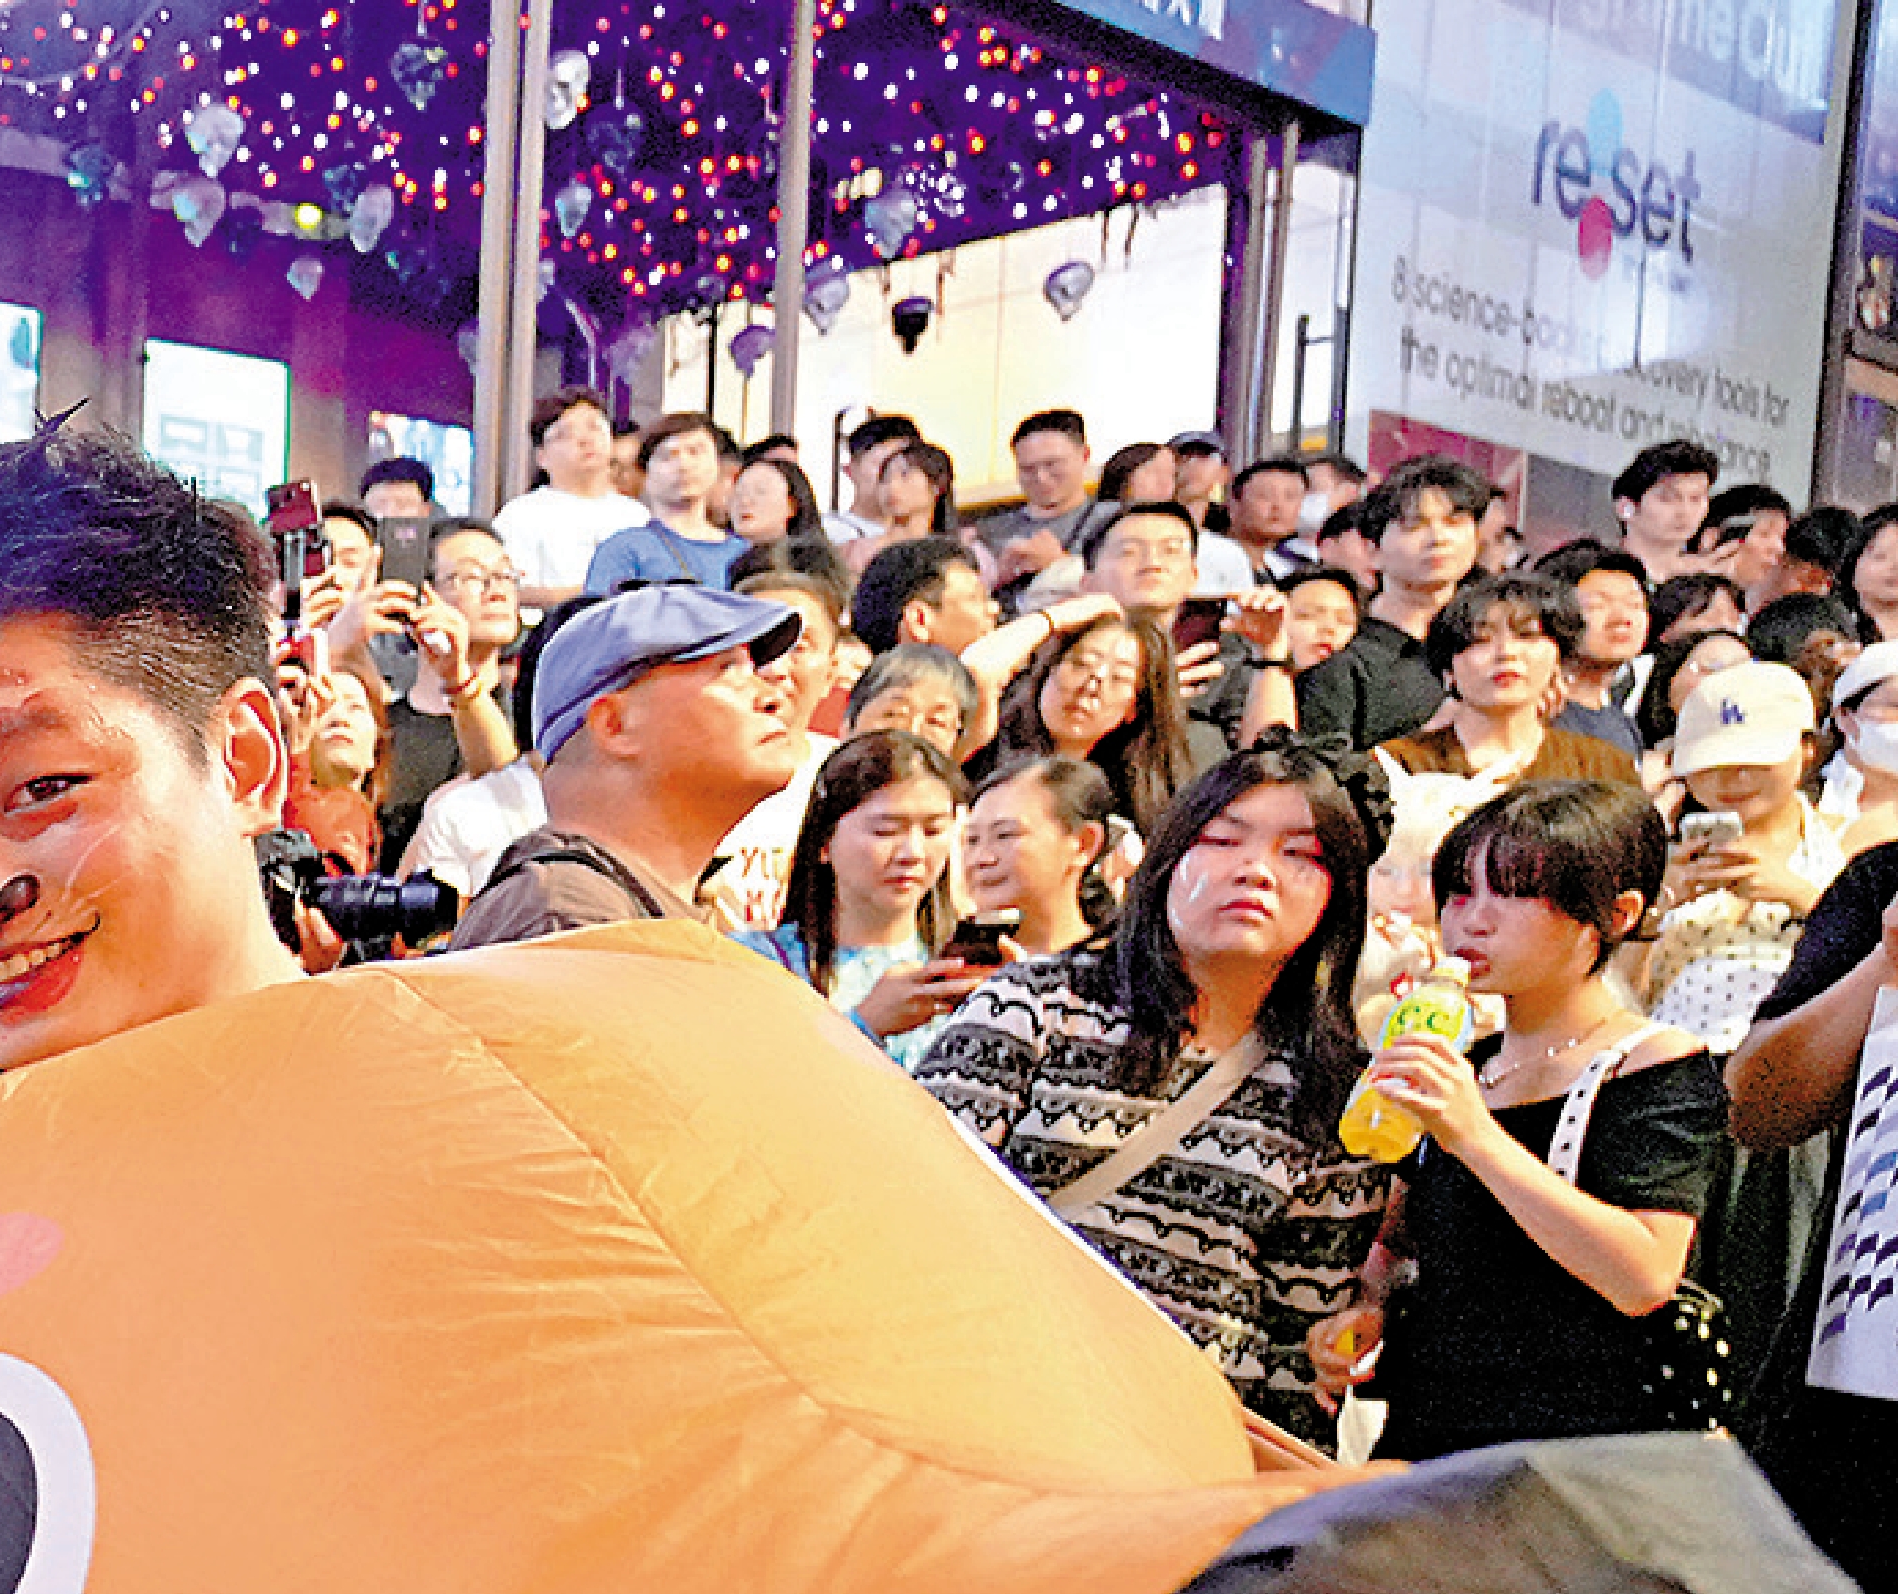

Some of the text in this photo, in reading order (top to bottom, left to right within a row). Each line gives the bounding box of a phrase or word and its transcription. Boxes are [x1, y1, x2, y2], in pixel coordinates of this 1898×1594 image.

[1531, 119, 1702, 264] reset
[1400, 325, 1439, 381] the
[1445, 350, 1537, 412] optimal
[1541, 377, 1617, 434] reboot
